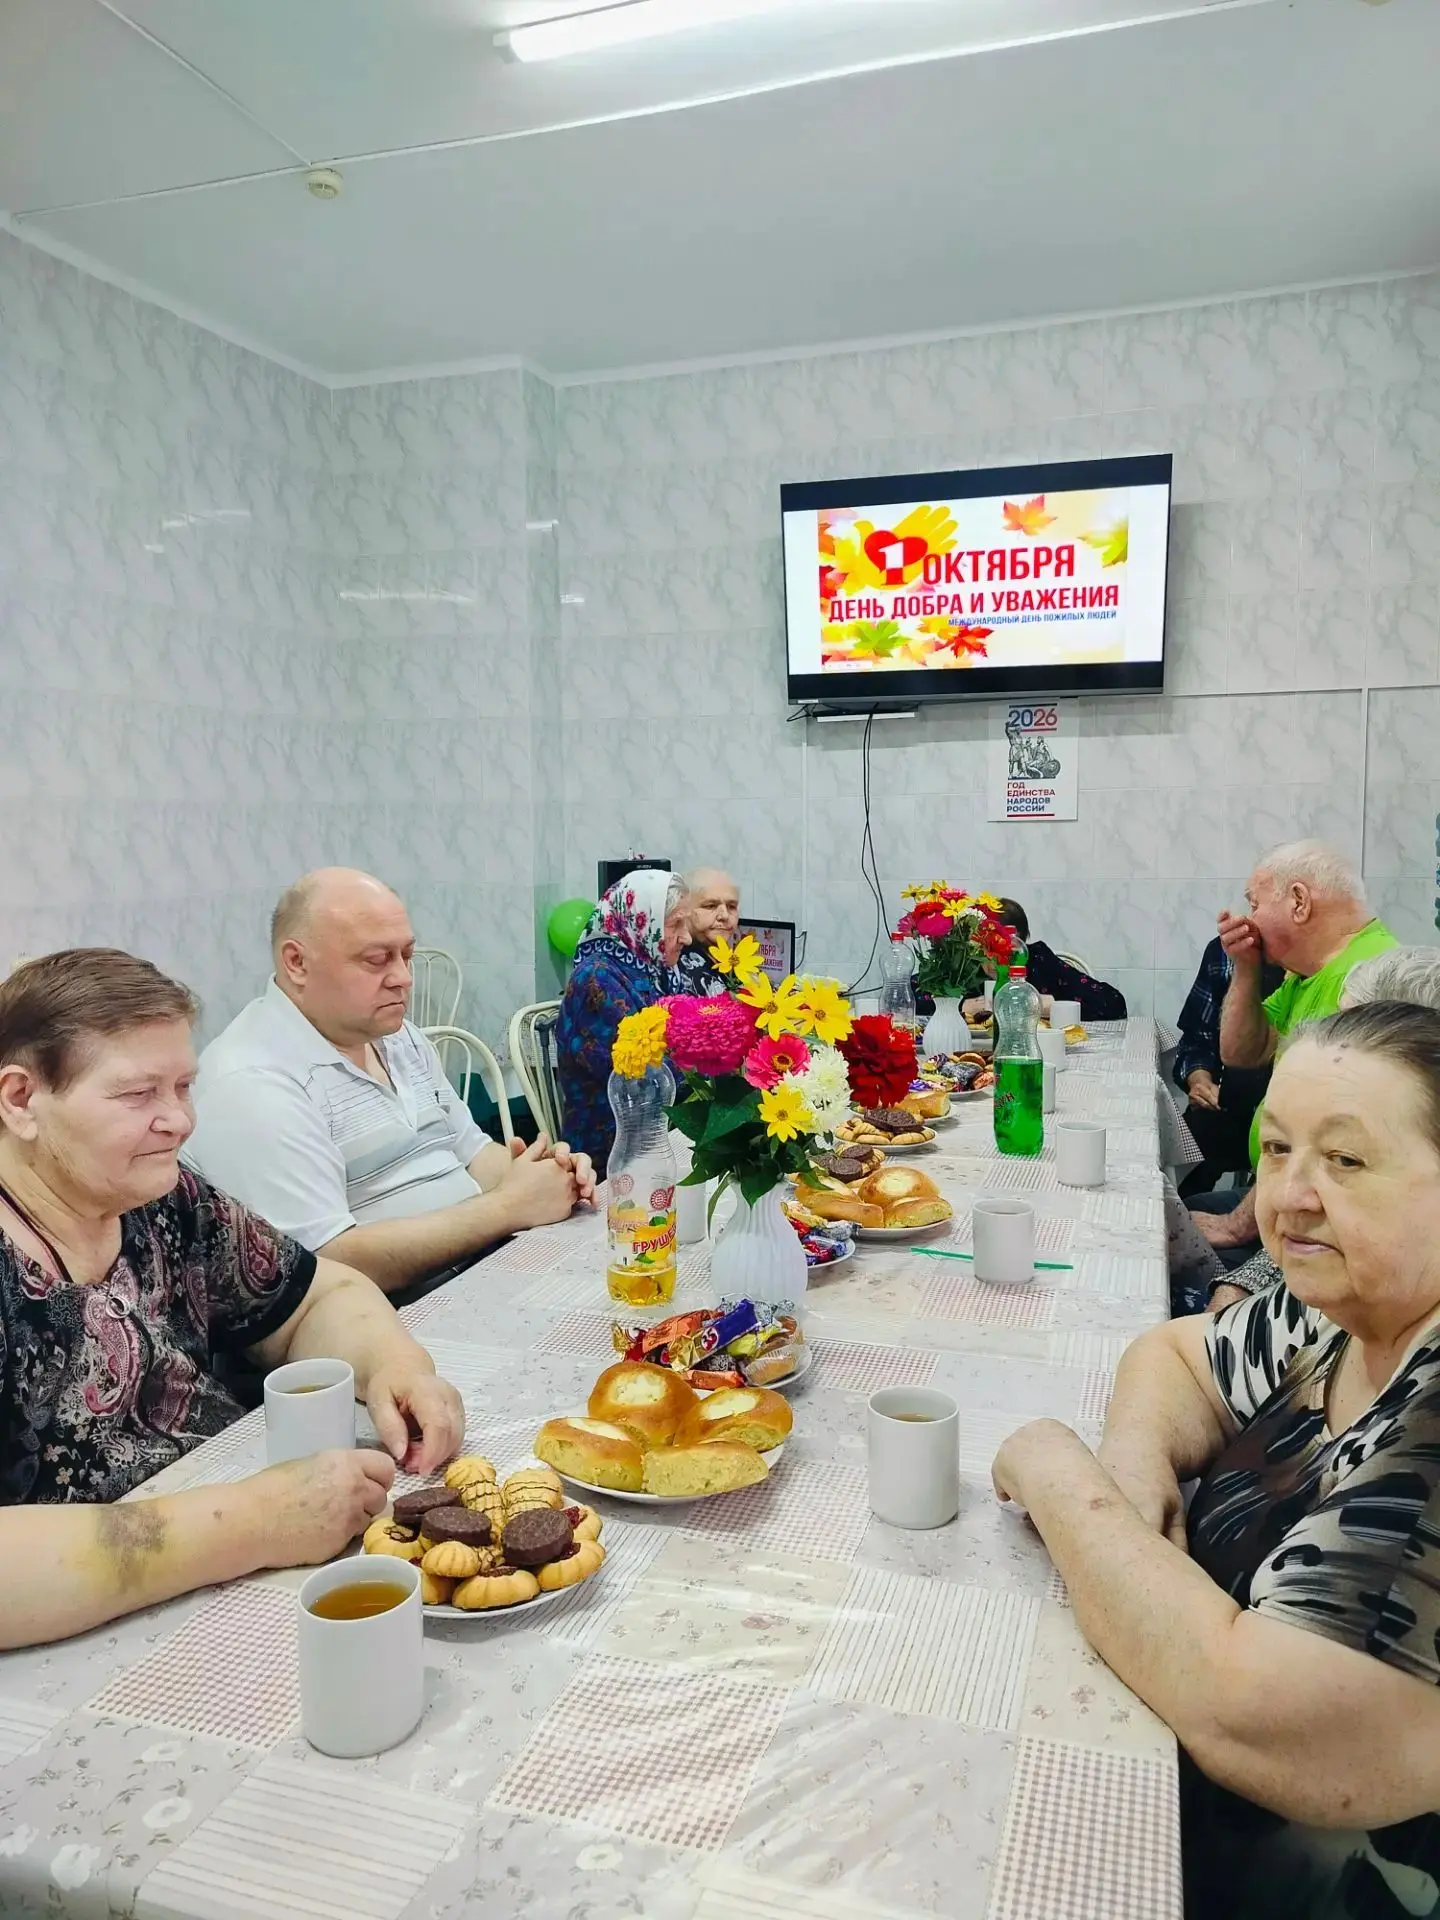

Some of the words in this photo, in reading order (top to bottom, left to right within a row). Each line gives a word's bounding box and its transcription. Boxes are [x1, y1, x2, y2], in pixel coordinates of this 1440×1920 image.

[878, 541, 908, 585] 1
[923, 544, 1075, 585] ОКТЯБРЯ
[829, 598, 885, 622] ДЕНЬ
[891, 594, 964, 619] ДОБРА
[970, 592, 984, 613] И
[991, 585, 1119, 612] УВАЖЕНИЯ
[948, 615, 1020, 627] МЕЖДУНАРОДНЫЙ
[1021, 614, 1042, 623] ДЕНЬ
[1043, 611, 1085, 622] ПОЖИЛЫХ
[1087, 609, 1117, 620] ЛЮДЕЙ
[1008, 708, 1058, 727] 2026
[1007, 782, 1025, 790] ГОД
[1007, 789, 1056, 797] ЕДИНСТВА
[1007, 797, 1051, 805] НАРОДОВ
[1007, 804, 1045, 813] РОССИИ
[632, 1223, 677, 1255] ГРУШЕ
